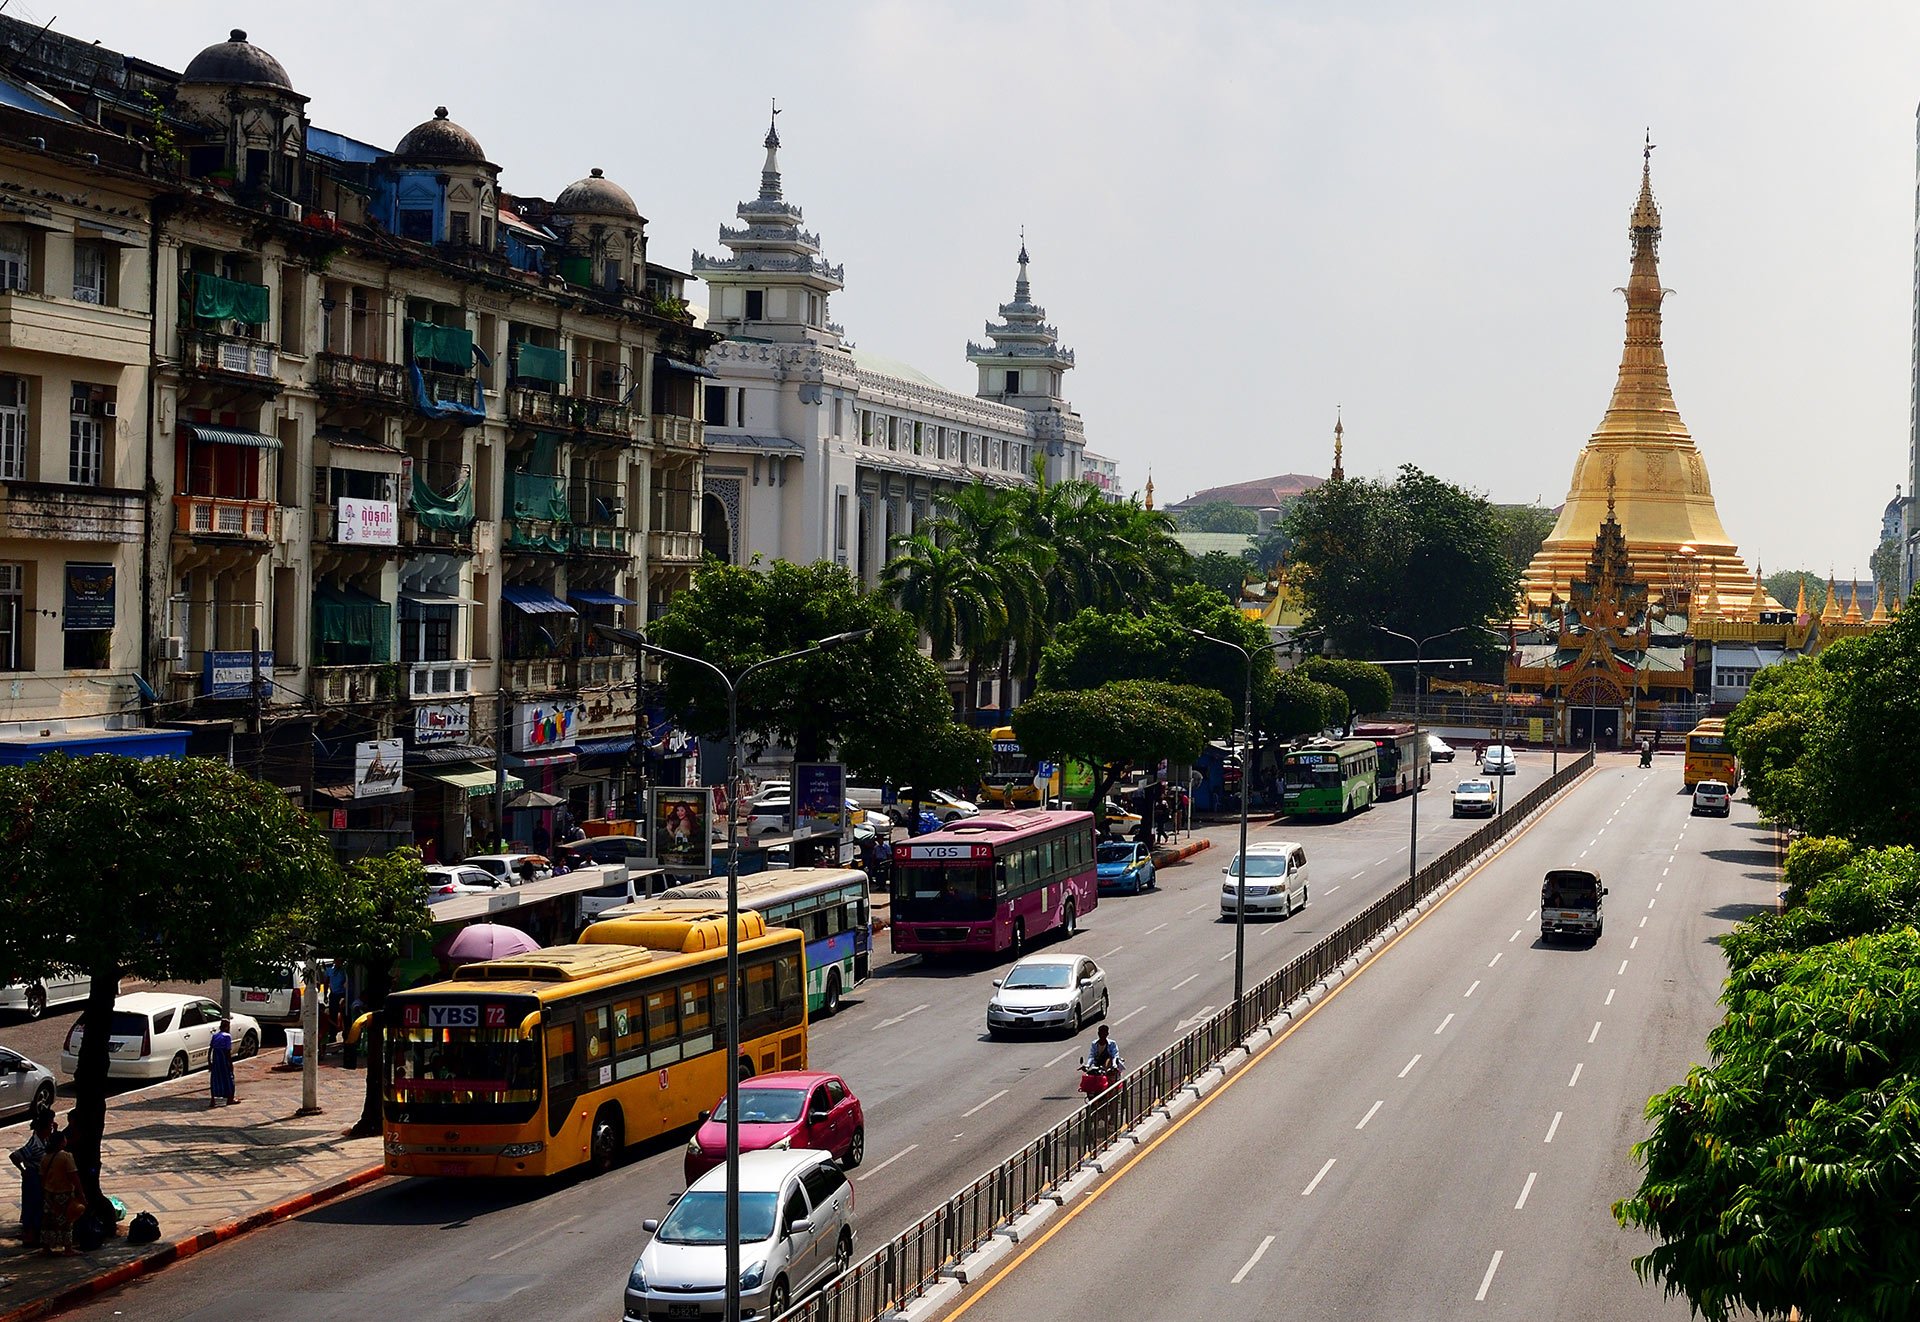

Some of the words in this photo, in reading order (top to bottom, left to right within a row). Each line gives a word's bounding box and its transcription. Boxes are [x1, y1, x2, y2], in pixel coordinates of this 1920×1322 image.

[1001, 743, 1020, 752] YBS
[1300, 755, 1322, 764] YBS
[1042, 763, 1050, 772] P
[924, 848, 958, 857] YBS
[976, 848, 987, 856] 12
[431, 1007, 477, 1025] YBS
[487, 1008, 505, 1023] 72
[386, 1131, 400, 1143] 72
